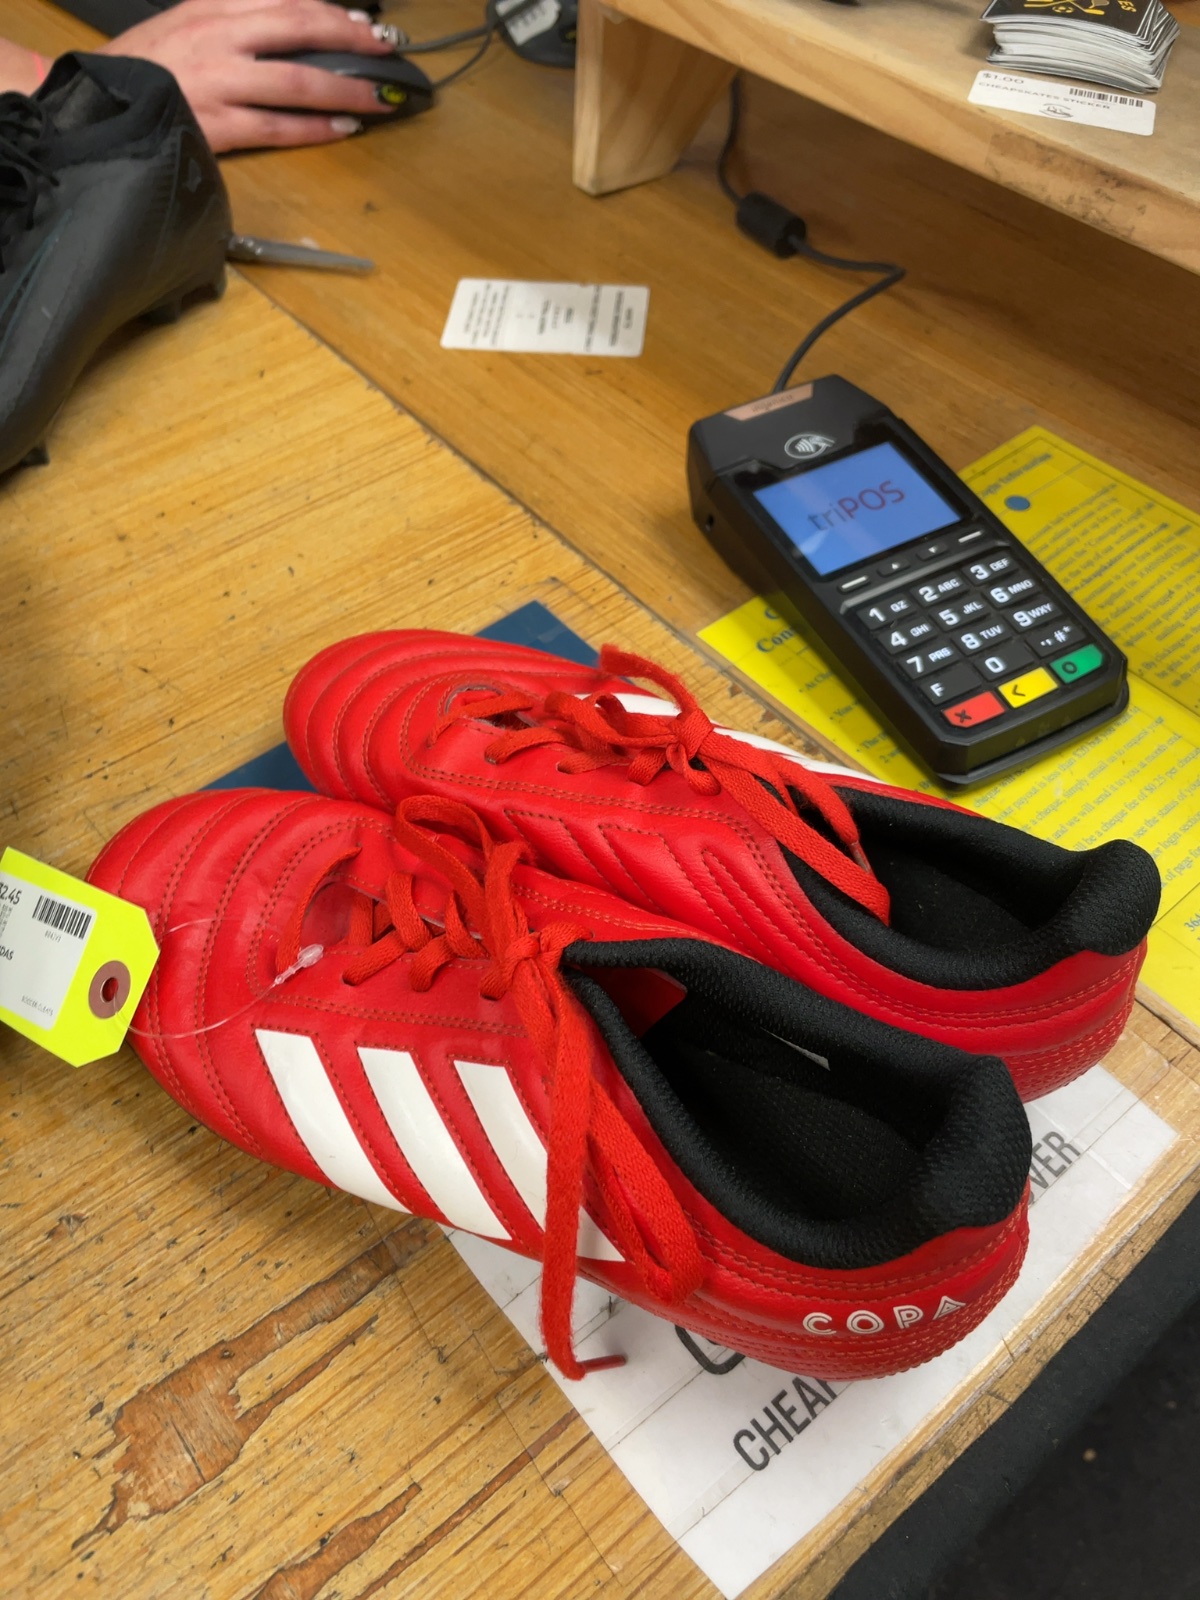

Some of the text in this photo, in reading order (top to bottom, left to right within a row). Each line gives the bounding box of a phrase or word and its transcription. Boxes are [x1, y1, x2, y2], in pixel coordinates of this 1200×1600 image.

[983, 72, 1025, 84] $1.00
[978, 82, 1111, 110] CHEAPSKATES STICKER
[808, 480, 905, 531] triPOS
[970, 558, 1010, 581] 3 DEF
[919, 578, 962, 602] 2 ABC
[990, 579, 1033, 603] 6 MNO
[869, 600, 909, 622] 1 QZ
[939, 601, 984, 626] 5 JKL
[1013, 603, 1054, 628] 9 WXY
[890, 623, 930, 647] 4 GHI
[961, 625, 1004, 650] 8 TUV
[906, 647, 952, 673] 7 PRS
[985, 657, 1004, 673] 0
[930, 683, 945, 697] F
[1012, 783, 1041, 809] payout
[1100, 806, 1129, 833] cheque
[802, 1296, 966, 1335] COPA
